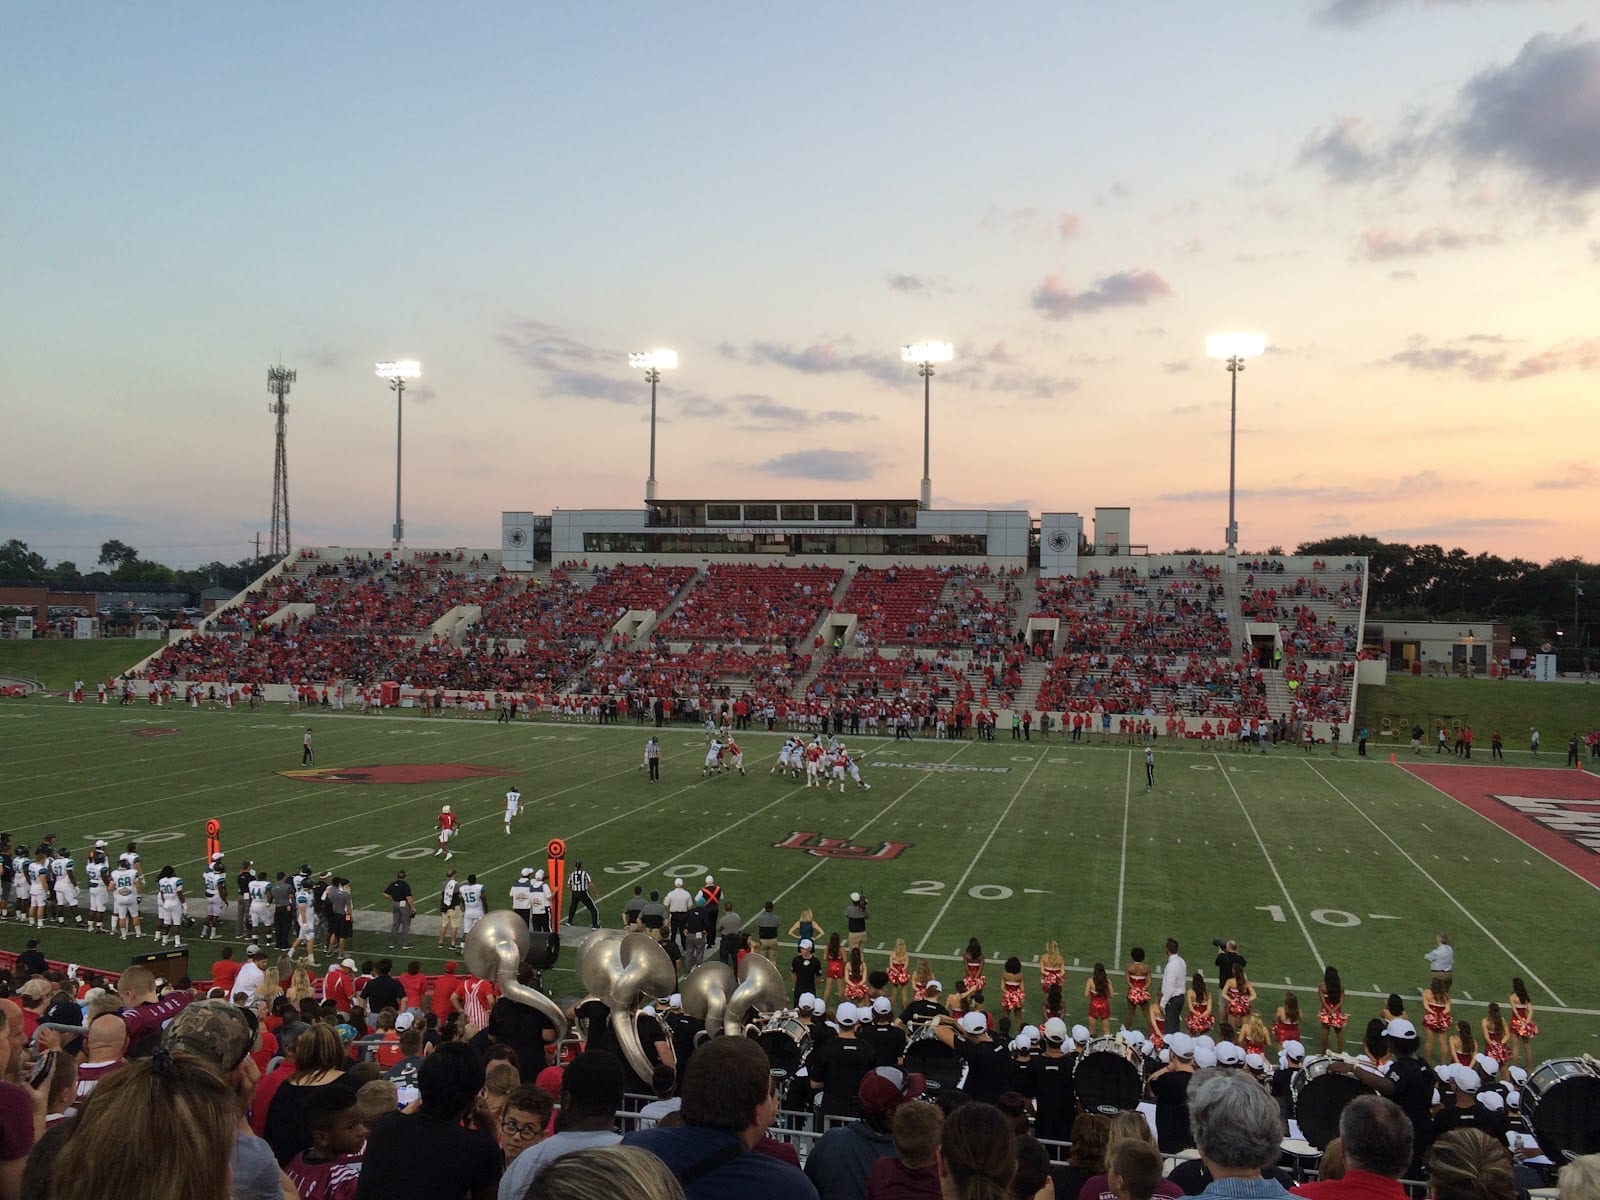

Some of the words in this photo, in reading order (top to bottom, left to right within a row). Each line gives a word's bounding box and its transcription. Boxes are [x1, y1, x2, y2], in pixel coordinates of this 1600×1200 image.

[603, 861, 709, 878] 30
[117, 876, 131, 887] 68
[902, 880, 1013, 900] 20
[251, 887, 262, 899] 44
[464, 891, 477, 903] 15
[1254, 905, 1362, 927] 10
[149, 998, 180, 1017] LOWE
